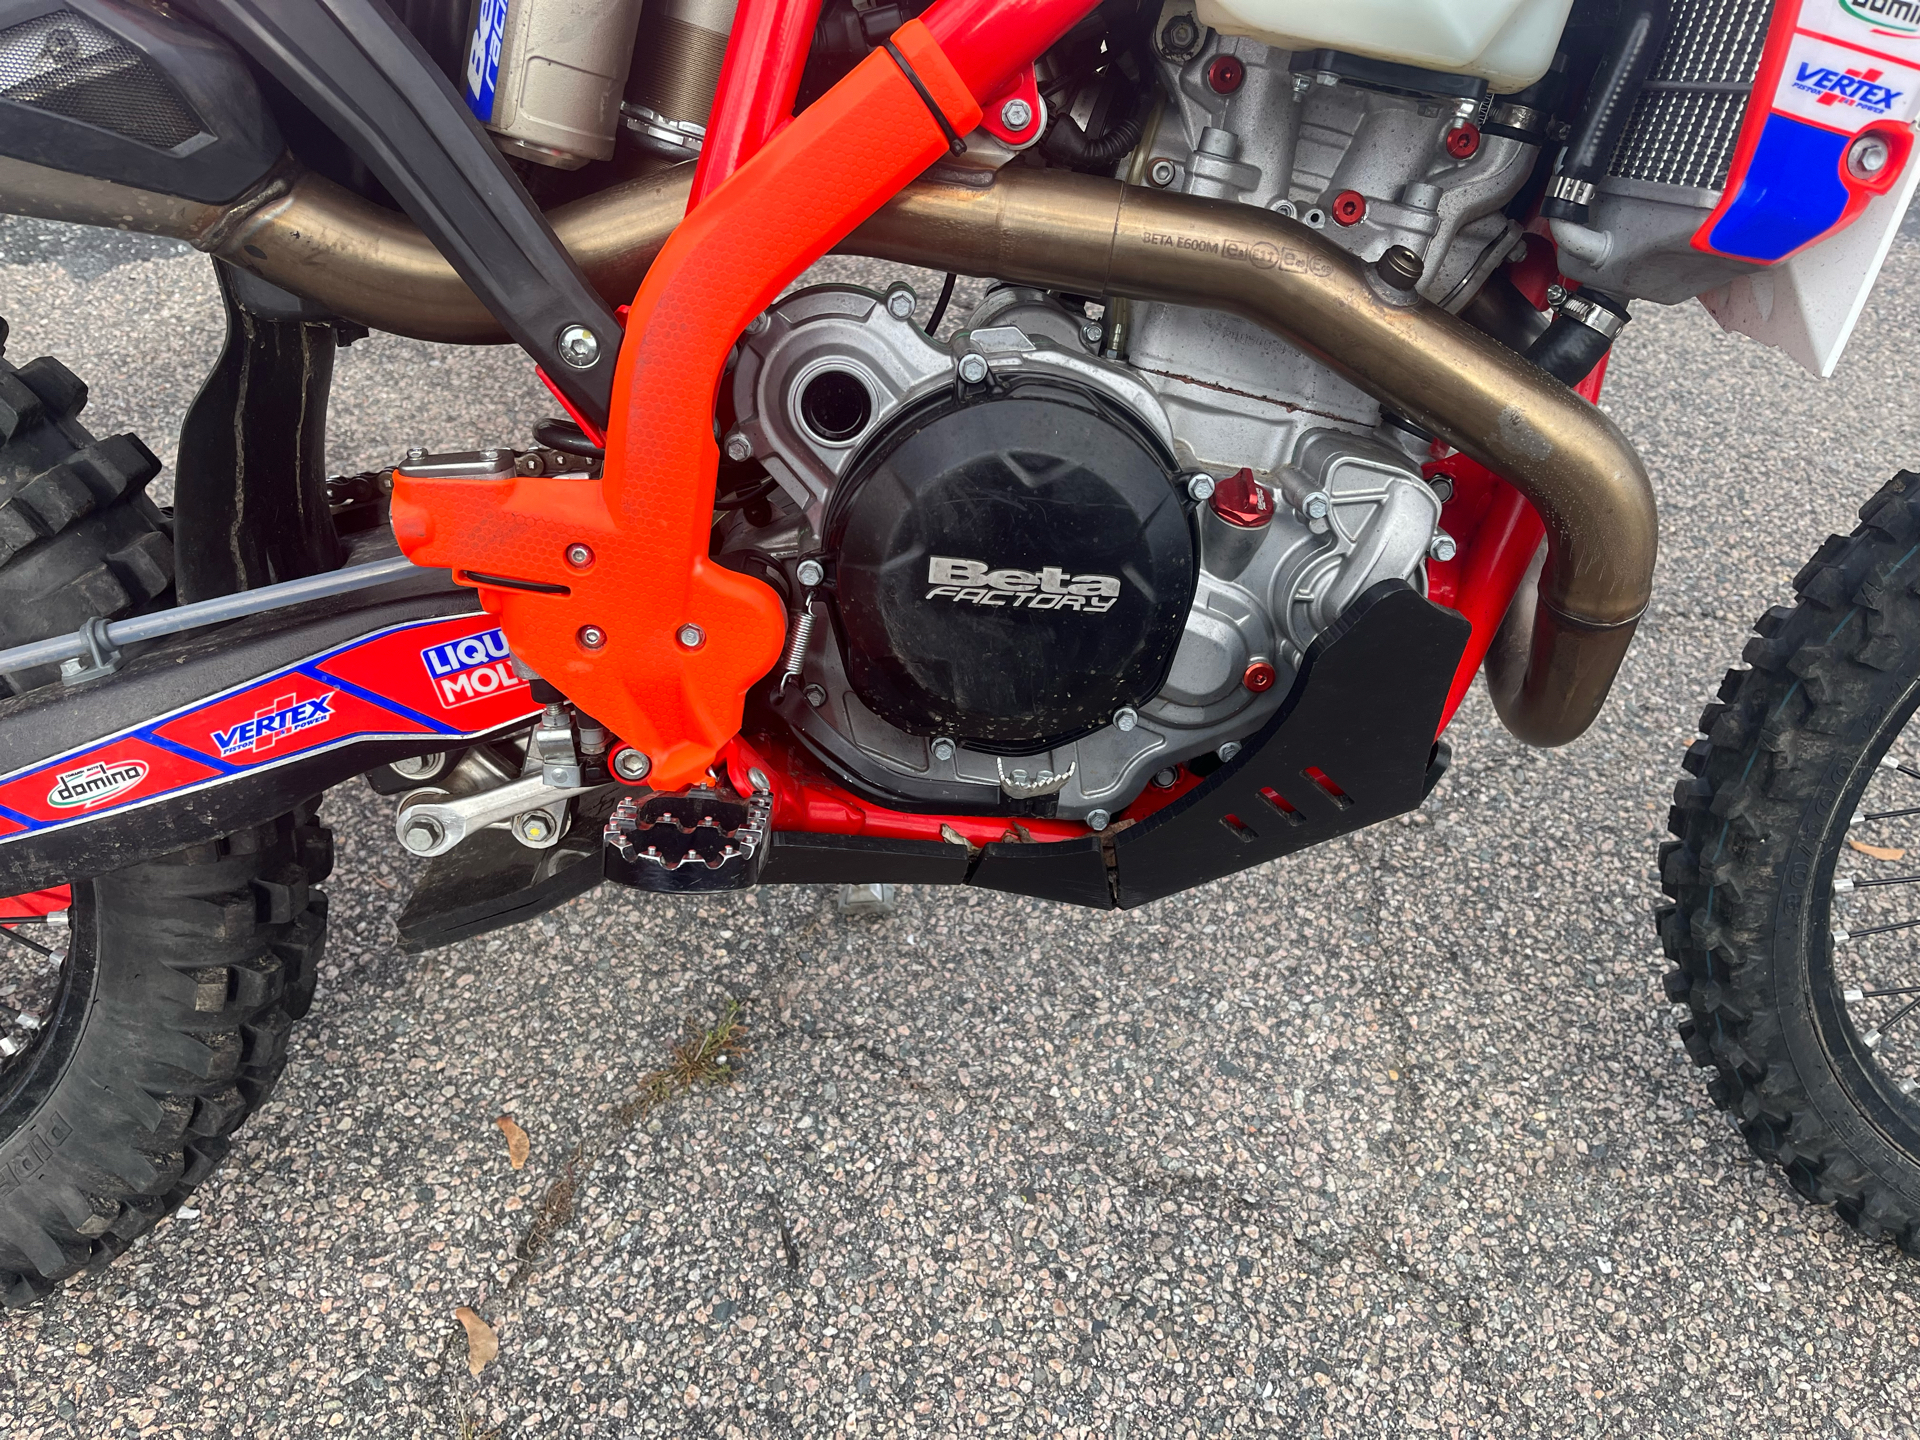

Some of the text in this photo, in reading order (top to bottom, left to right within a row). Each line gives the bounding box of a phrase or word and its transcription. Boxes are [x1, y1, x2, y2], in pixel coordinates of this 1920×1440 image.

[486, 0, 508, 93] raci
[1792, 82, 1823, 95] PISTON
[1856, 102, 1885, 114] POWER
[1796, 62, 1904, 109] VERTEX
[1143, 232, 1173, 247] BETA
[1177, 236, 1219, 254] E600M
[928, 556, 1121, 598] Beta
[925, 586, 1118, 613] FACTORY
[212, 694, 332, 750] VERTEX
[223, 739, 255, 755] PISTON
[293, 714, 328, 731] POWER
[57, 763, 141, 801] domino
